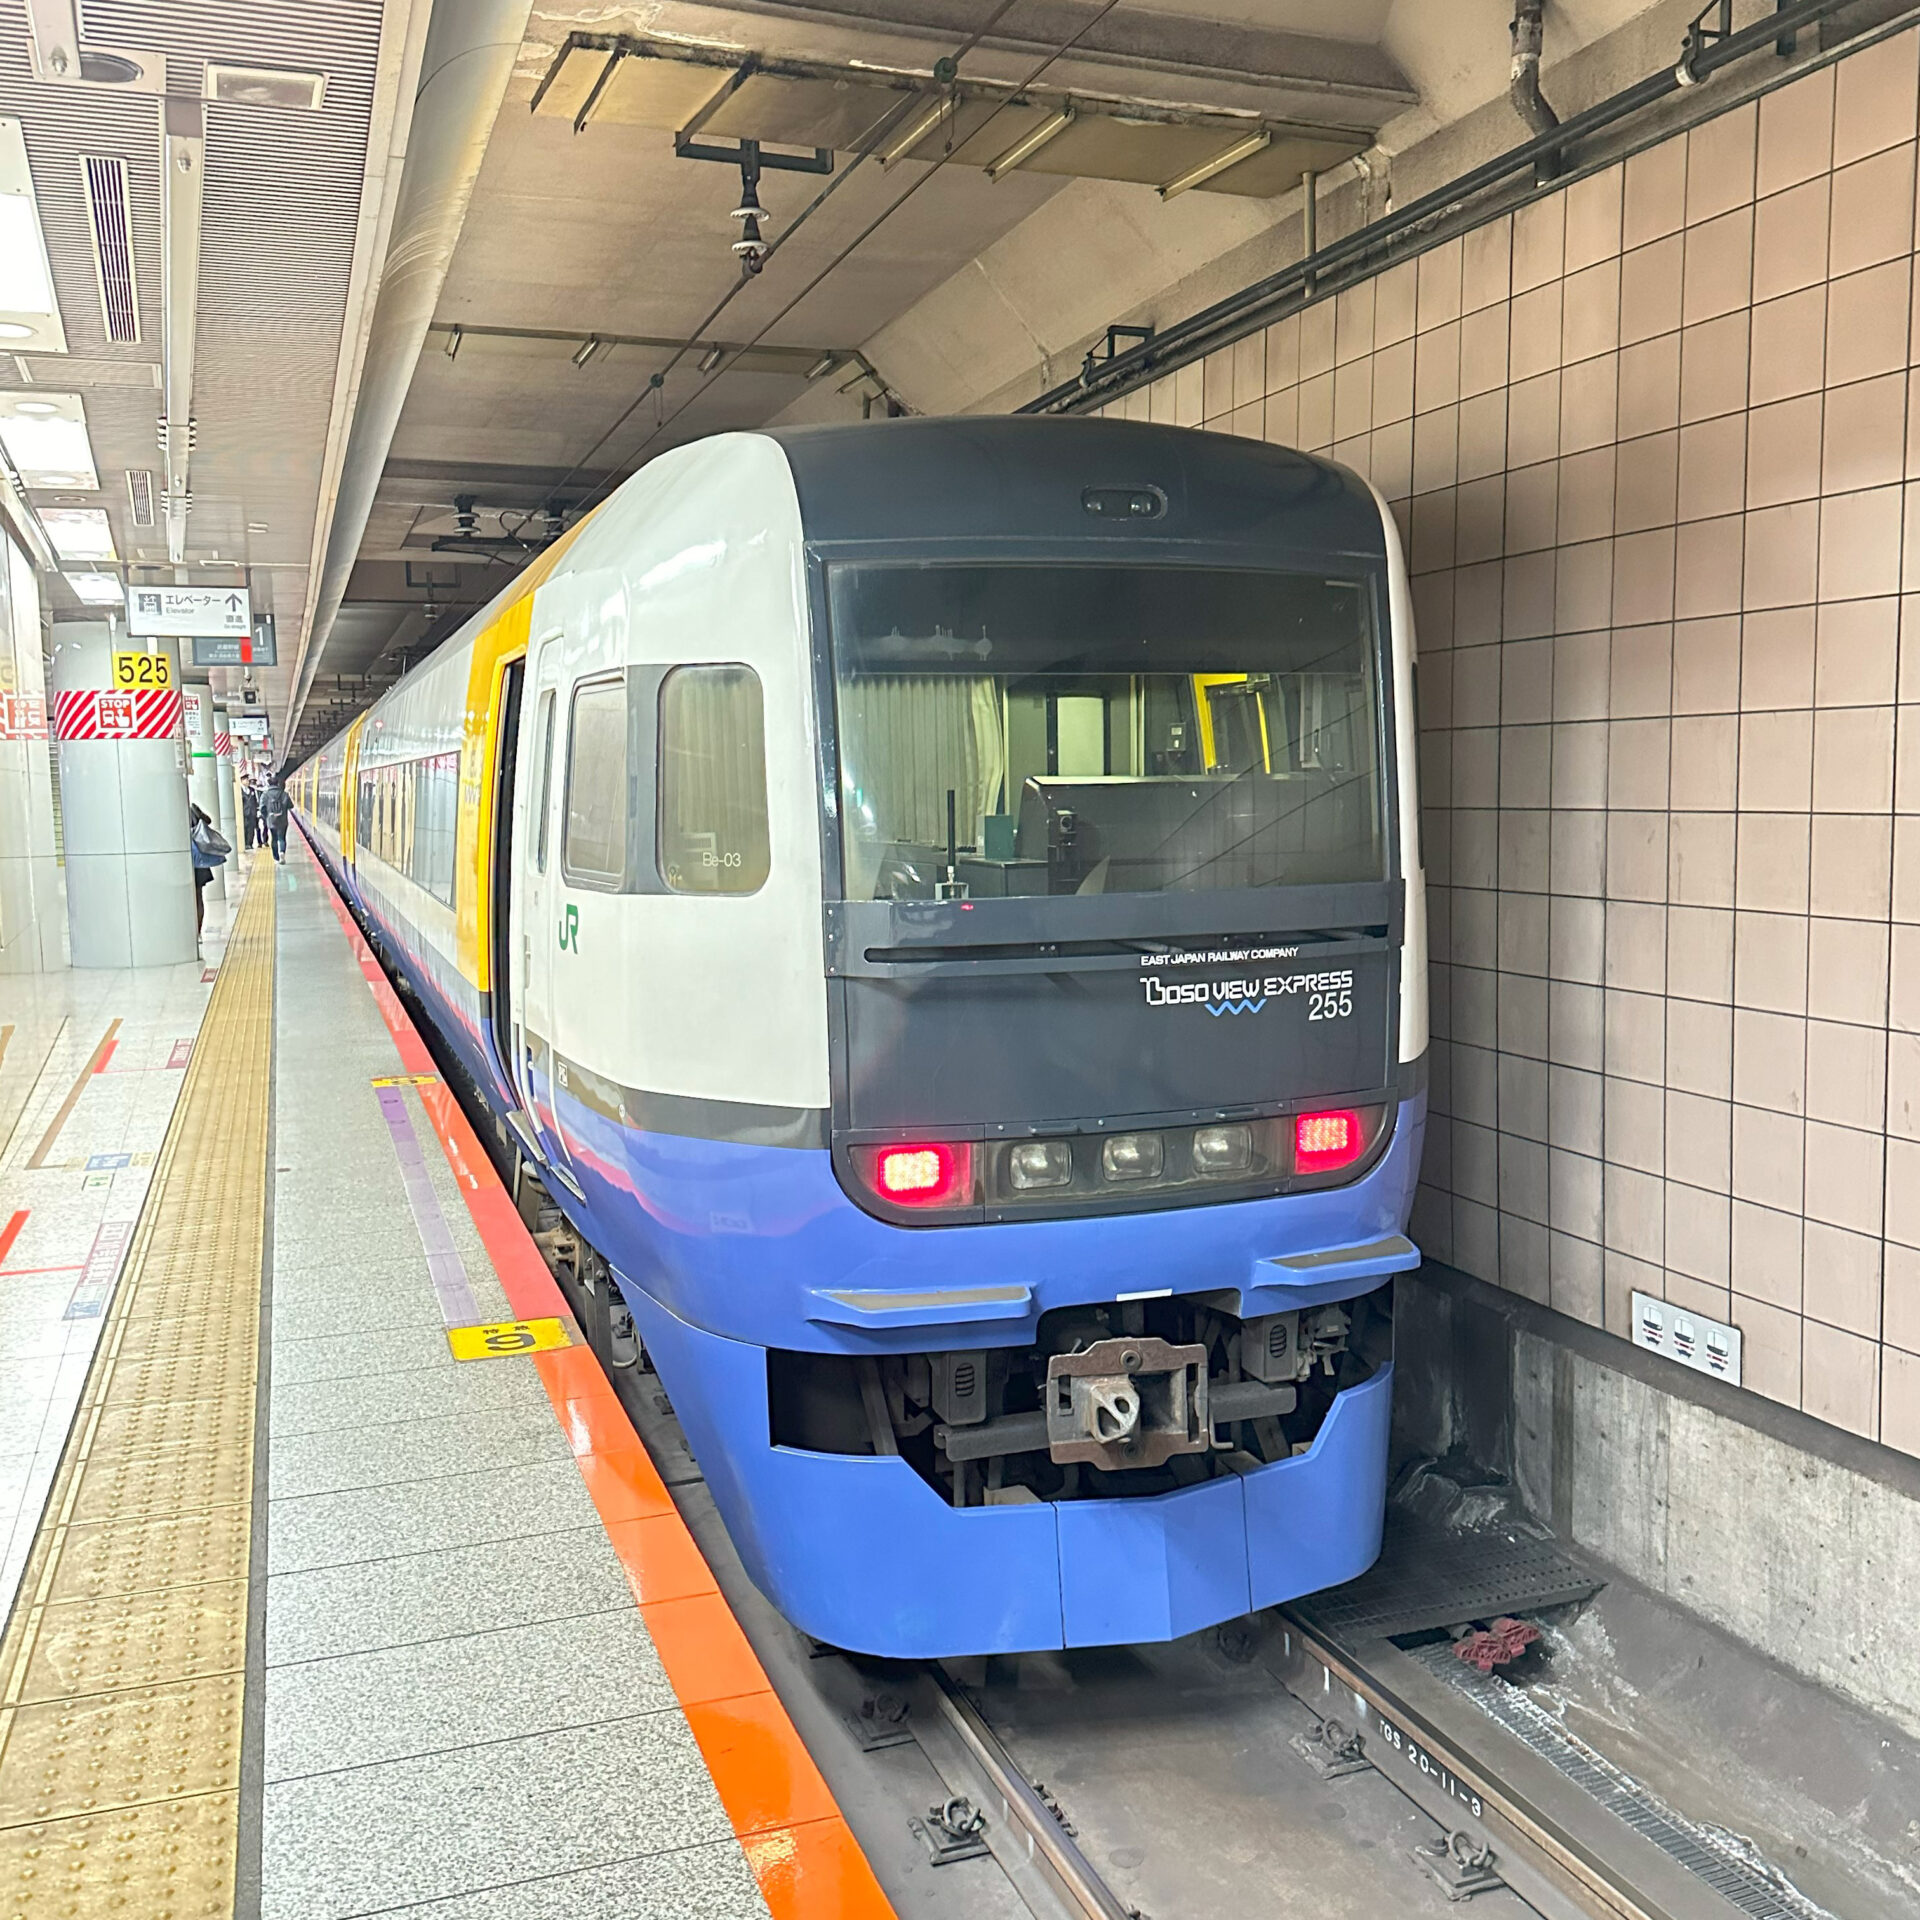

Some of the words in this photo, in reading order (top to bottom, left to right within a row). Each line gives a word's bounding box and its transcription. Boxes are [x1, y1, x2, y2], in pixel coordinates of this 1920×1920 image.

[165, 594, 221, 606] エレベーター
[255, 626, 265, 647] 1
[118, 656, 168, 684] 525
[100, 699, 131, 709] STOP
[702, 852, 742, 867] Be-03
[558, 903, 579, 955] JR
[1141, 954, 1171, 966] EAST
[1170, 952, 1206, 965] JAPAN
[1207, 950, 1250, 962] RAILWAY
[1250, 947, 1299, 959] COMPANY
[1212, 978, 1260, 1001] VIEW
[1263, 969, 1353, 996] EXPRESS
[1308, 989, 1353, 1021] 255
[485, 1333, 536, 1351] 9
[1408, 1744, 1481, 1817] 20-11-3
